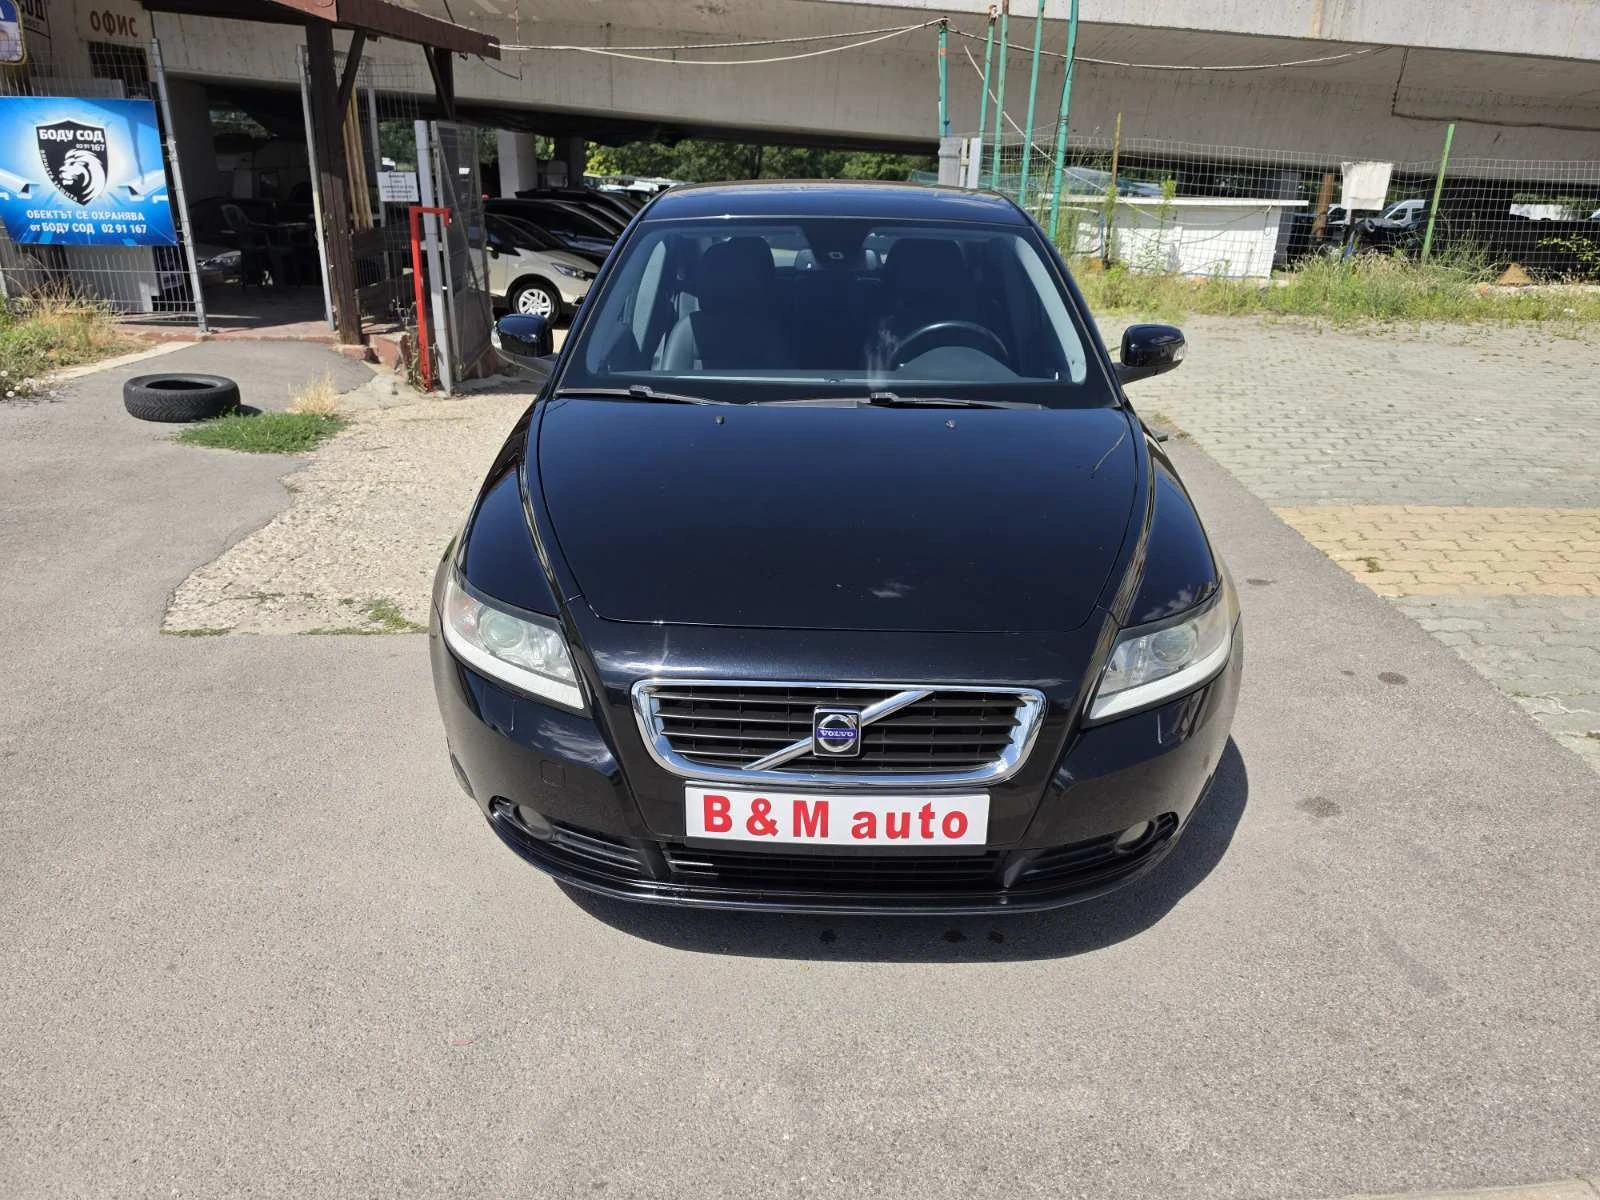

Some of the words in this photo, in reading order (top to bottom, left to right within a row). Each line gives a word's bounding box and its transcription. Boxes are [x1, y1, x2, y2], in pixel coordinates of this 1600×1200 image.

[90, 9, 138, 37] ОФИС
[39, 129, 74, 142] БОДУ
[76, 130, 105, 143] СОД
[91, 143, 105, 151] 167
[26, 209, 73, 220] ОБЕКТЪТ
[75, 210, 89, 220] СЕ
[91, 210, 145, 221] ОХРАНЯВА
[30, 223, 41, 232] от
[41, 222, 70, 234] БОДУ
[71, 222, 96, 235] СОД
[101, 223, 114, 234] 02
[114, 223, 128, 234] 91
[129, 223, 147, 234] 167
[820, 729, 854, 737] VOLVO
[703, 794, 733, 833] B
[745, 797, 779, 837] &
[792, 799, 830, 839] M
[850, 801, 970, 840] auto
